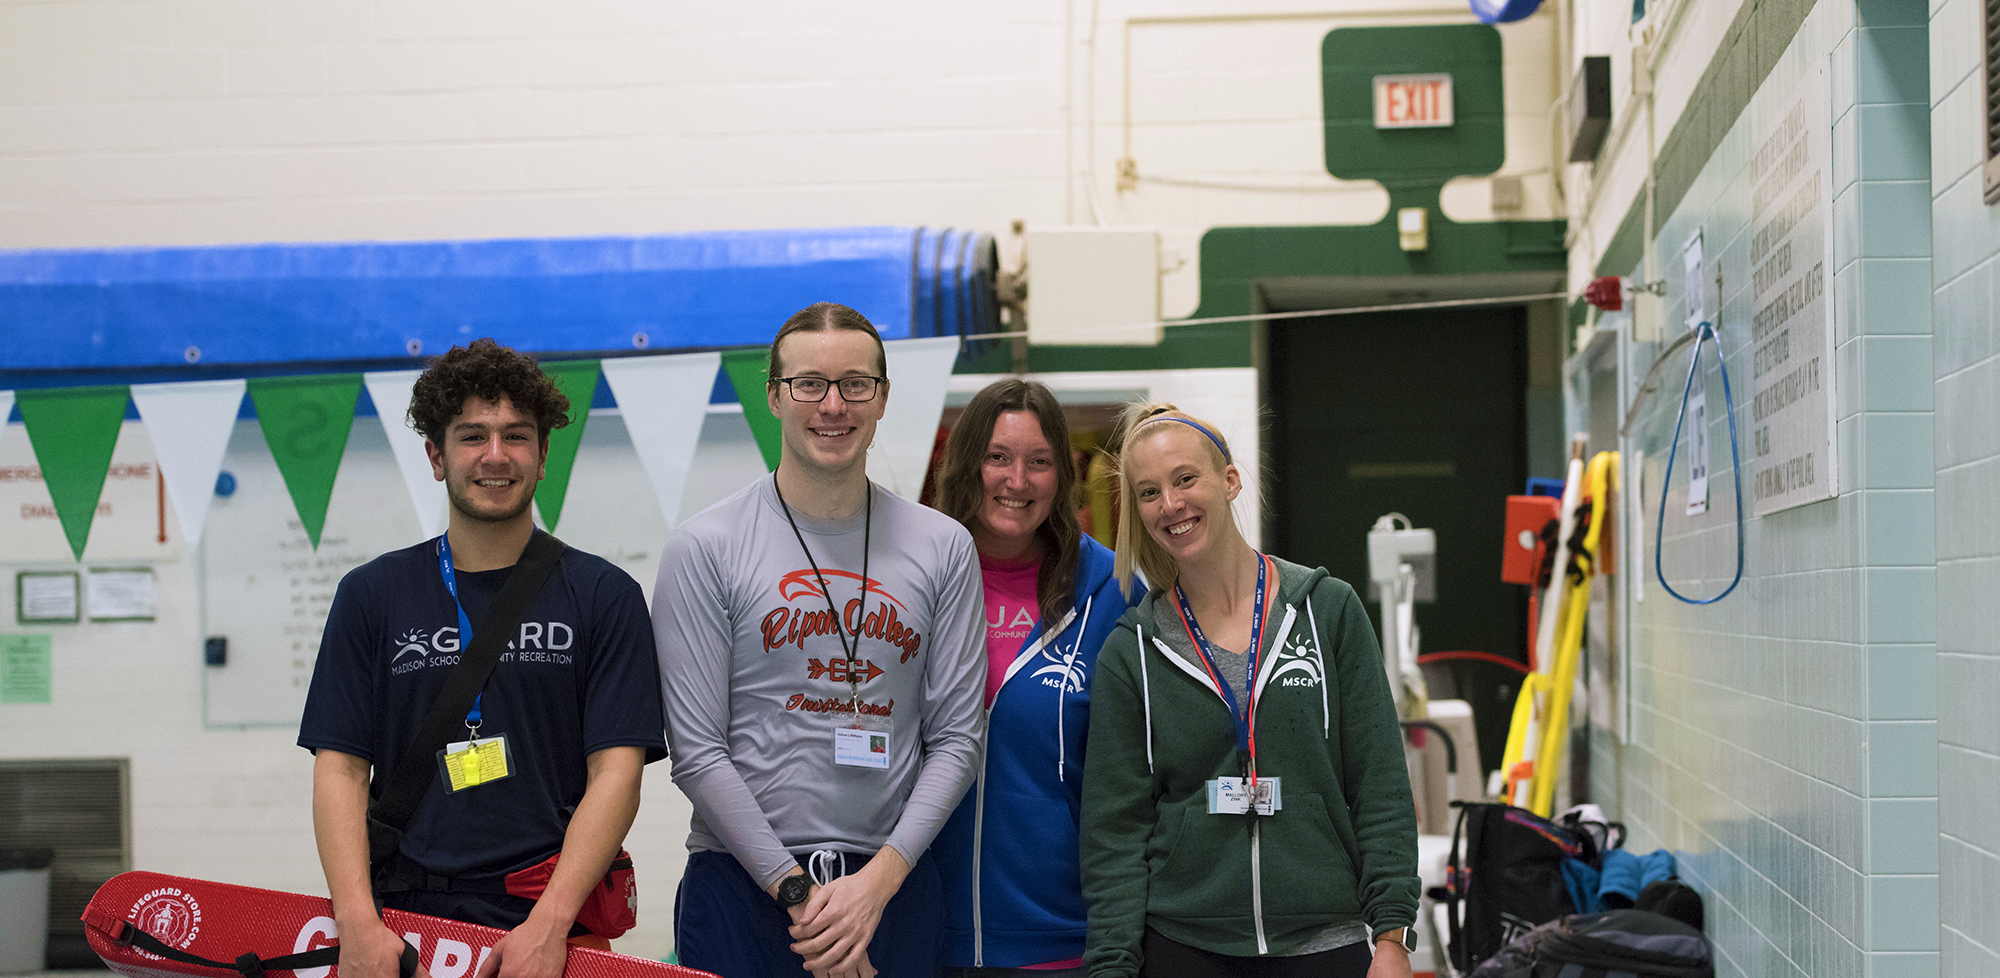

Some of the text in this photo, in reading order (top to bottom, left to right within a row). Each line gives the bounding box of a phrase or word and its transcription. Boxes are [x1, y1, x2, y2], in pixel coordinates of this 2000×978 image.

[1387, 82, 1442, 121] EXIT
[761, 598, 921, 664] Ripon College
[391, 659, 426, 676] MADISON
[429, 655, 462, 668] SCHOO
[519, 653, 573, 664] RECREATION
[1282, 677, 1314, 688] MSCR
[128, 887, 182, 919] LIFEGUARD
